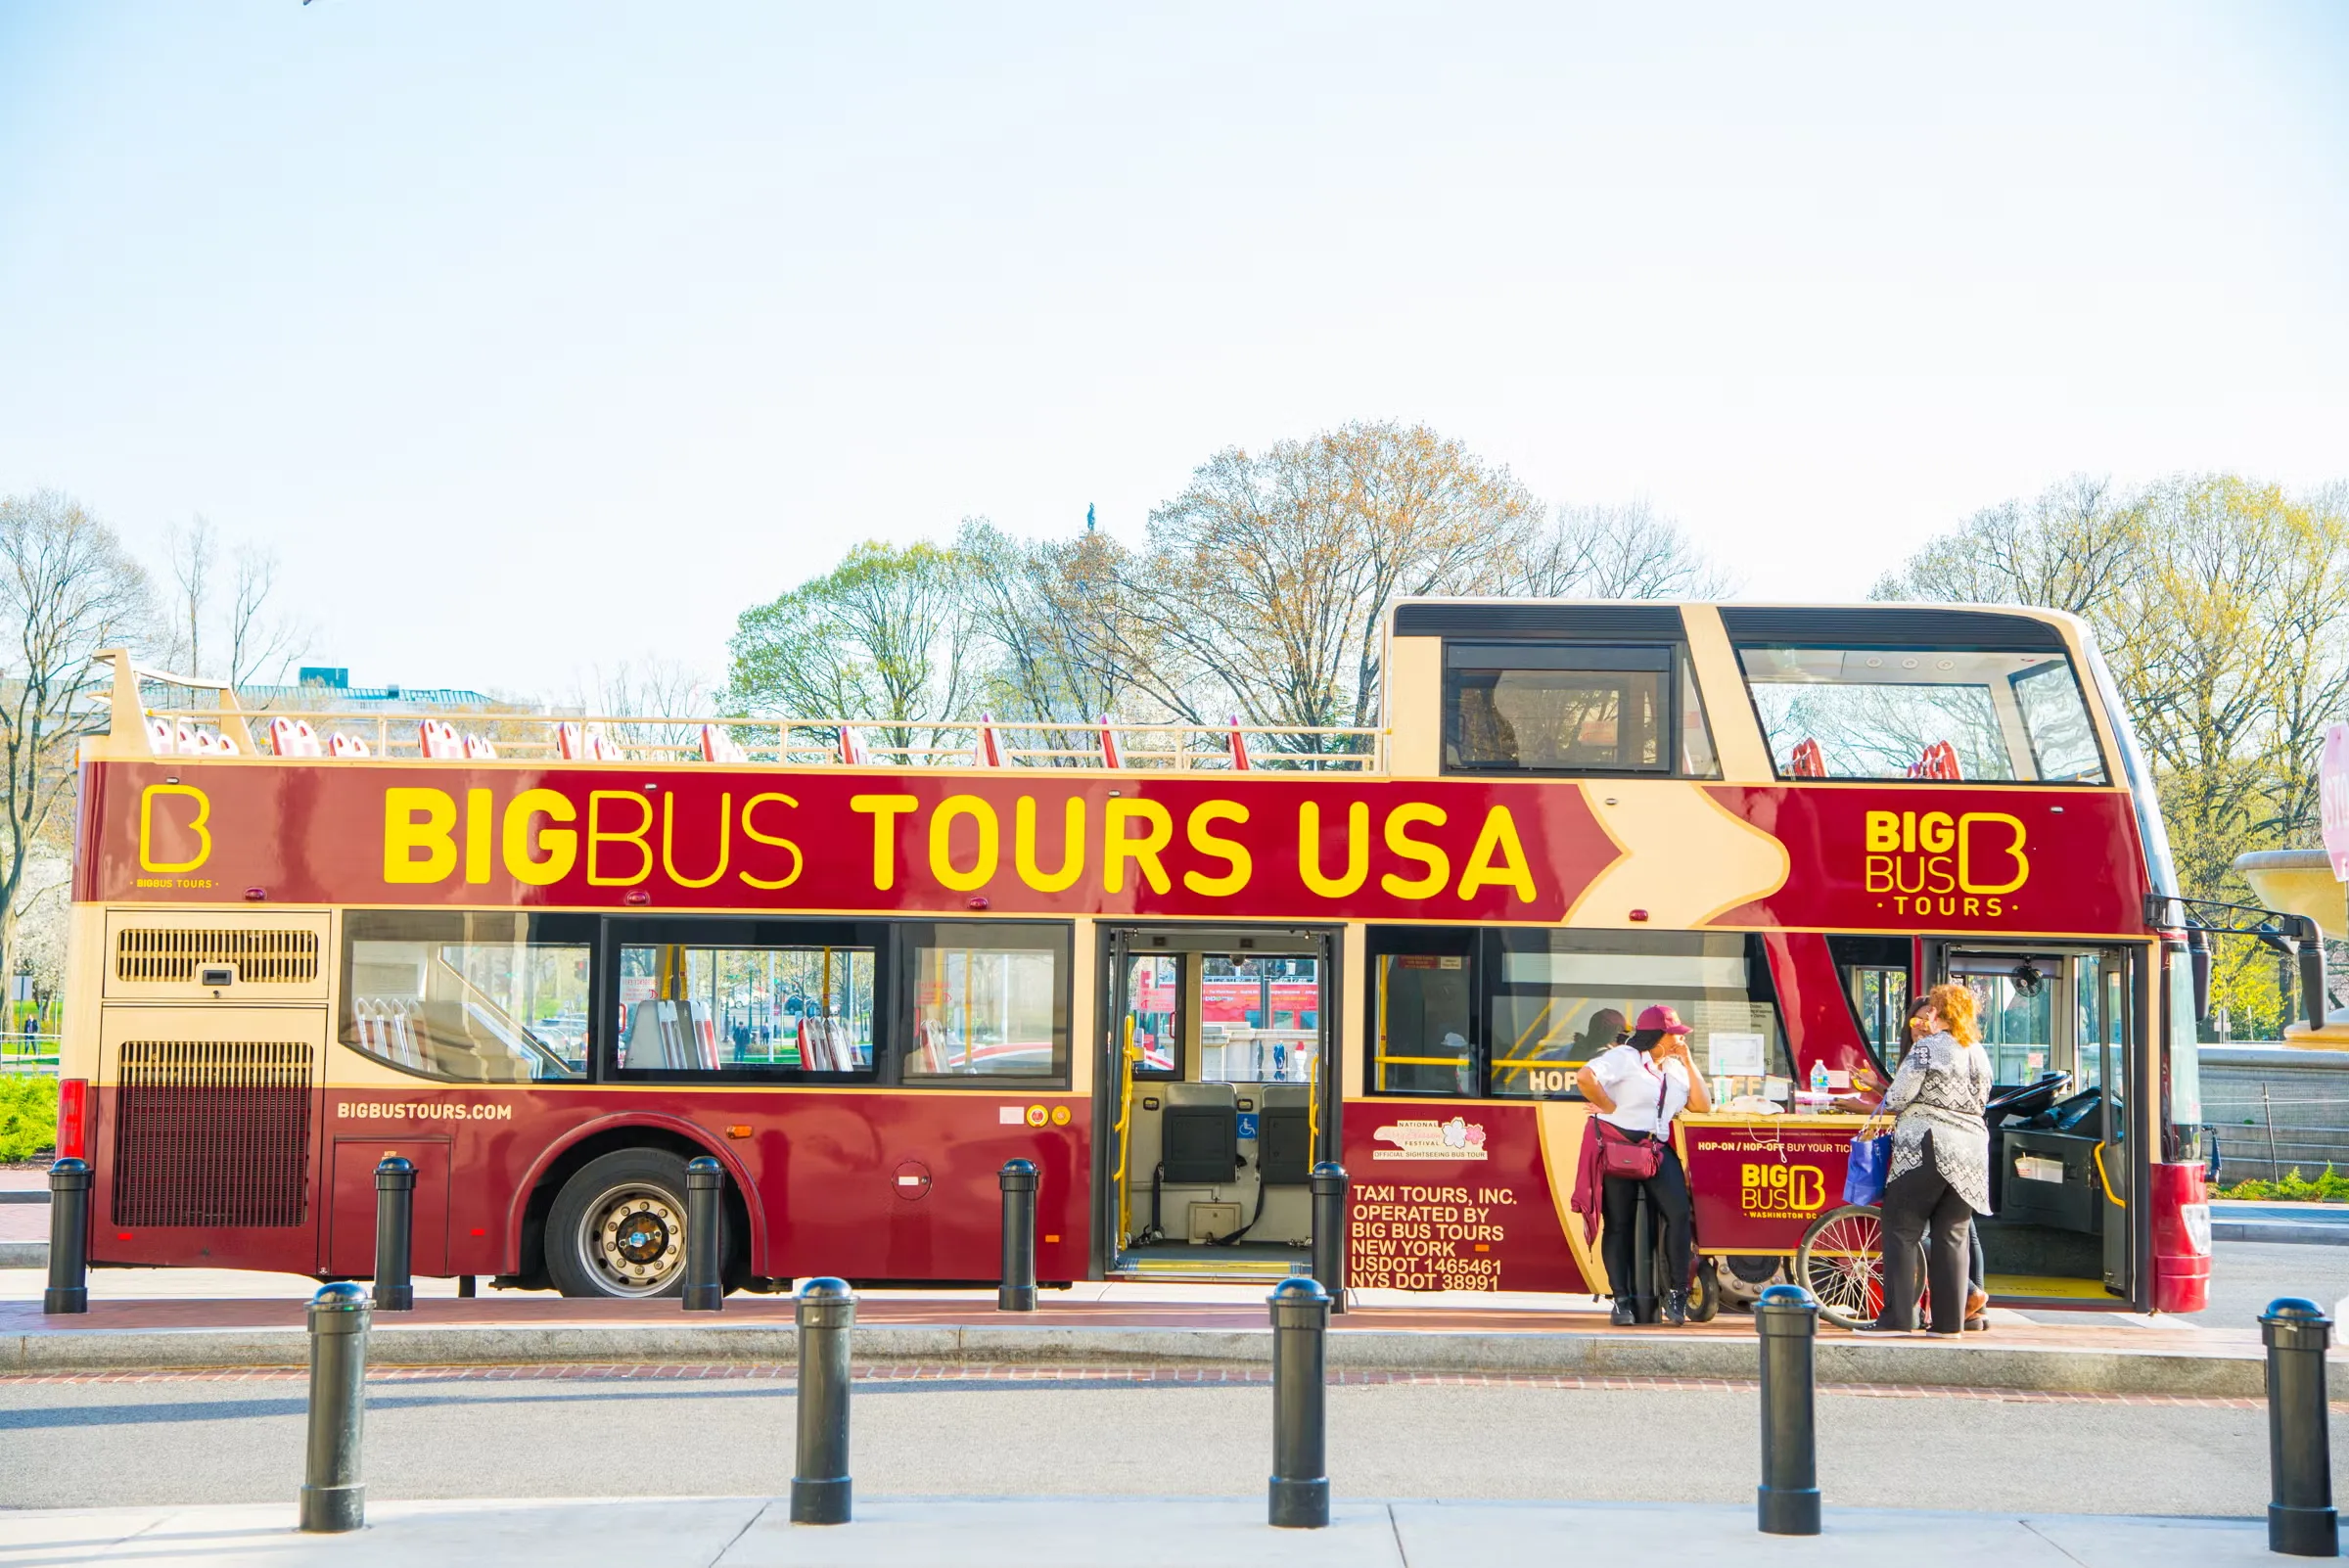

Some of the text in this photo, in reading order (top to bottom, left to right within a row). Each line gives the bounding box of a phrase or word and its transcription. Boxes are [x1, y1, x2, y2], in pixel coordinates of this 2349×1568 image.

[1865, 810, 1956, 853] BIG
[849, 793, 1254, 898] TOURS
[1297, 800, 1539, 905] USA
[136, 878, 212, 889] BIGBUS TOURS
[1865, 854, 1956, 895] BUS
[1893, 896, 2003, 917] TOURS
[337, 1102, 512, 1120] BIGBUSTOURS.COM
[1698, 1142, 1735, 1151] HOP-ON
[1743, 1143, 1785, 1152] HOP-OFF
[1808, 1144, 1832, 1153] YOUR
[1834, 1144, 1853, 1154] TIC
[1742, 1164, 1788, 1187] BIG
[1353, 1185, 1517, 1206] TAXI TOURS, INC.
[1742, 1188, 1788, 1209] BUS
[1353, 1205, 1490, 1223] OPERATED BY
[1352, 1222, 1504, 1241] BIG BUS TOURS
[1352, 1240, 1456, 1258] NEW YORK
[1352, 1257, 1502, 1275] USDOT 1465461
[1351, 1272, 1498, 1292] NYS DOT 38991
